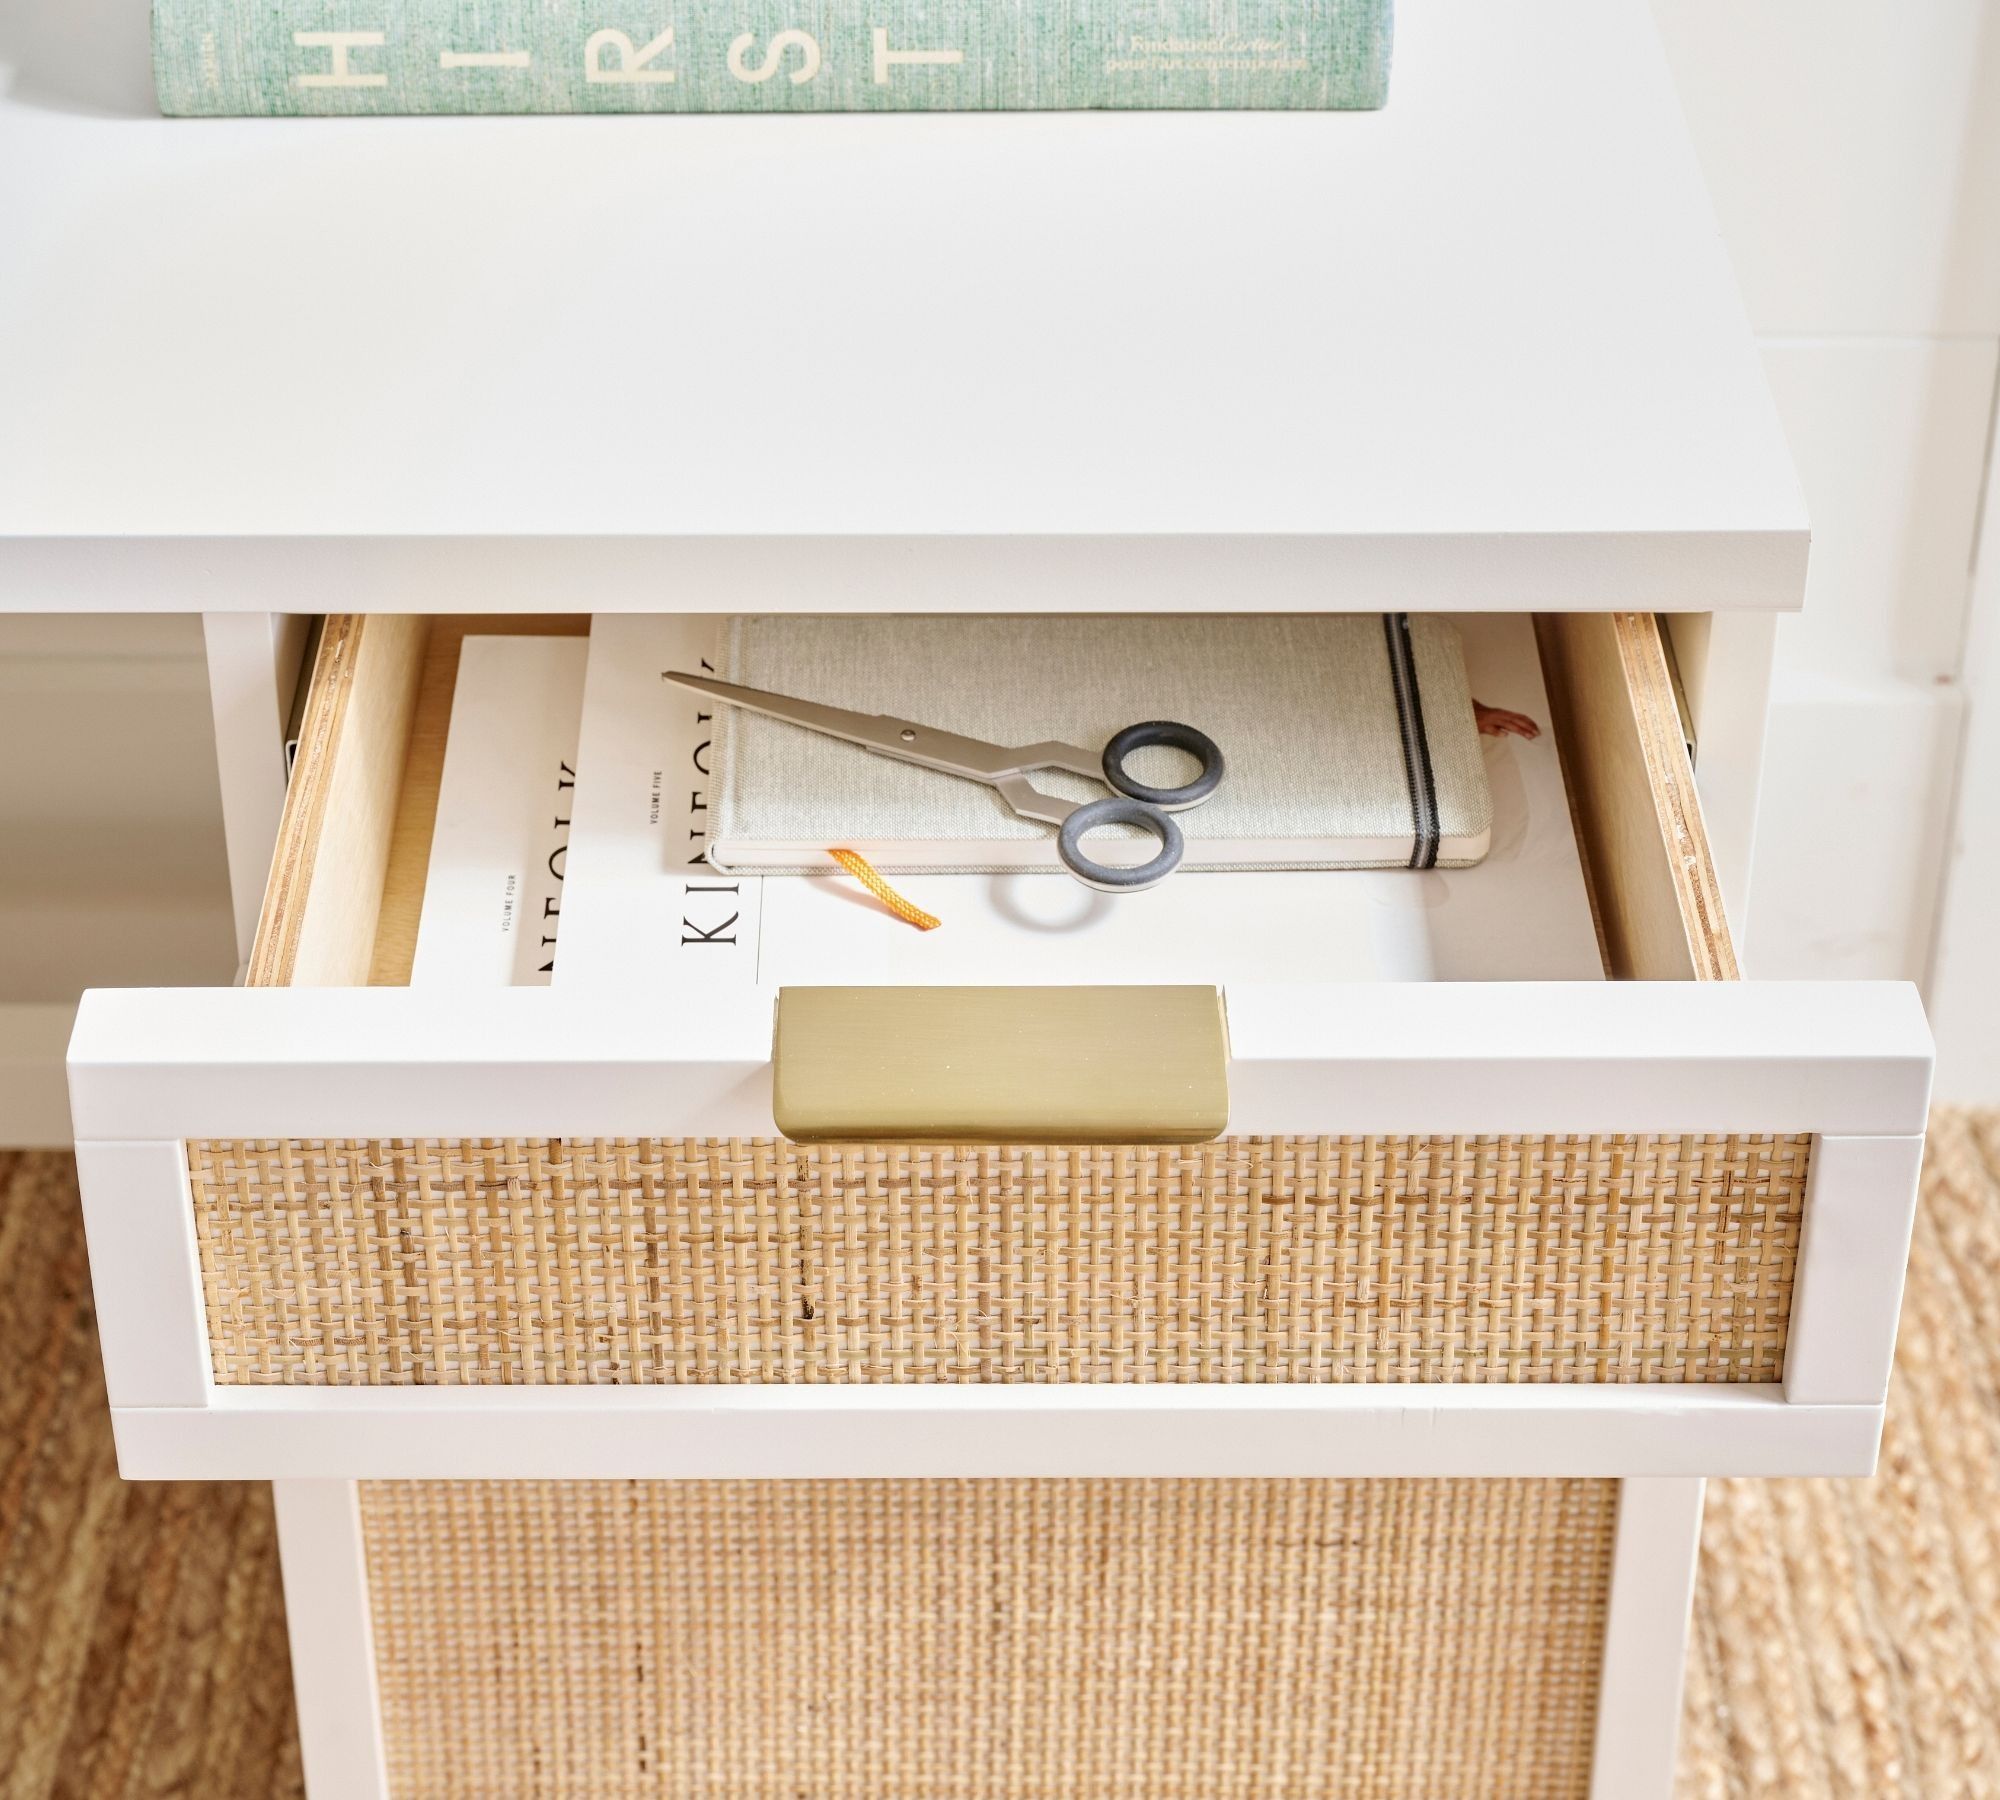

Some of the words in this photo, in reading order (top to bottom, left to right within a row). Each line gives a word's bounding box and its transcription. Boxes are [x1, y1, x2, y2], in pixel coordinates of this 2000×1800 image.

[293, 26, 962, 87] HIRST
[652, 770, 662, 789] FIVE
[650, 792, 660, 825] VOLUME
[505, 874, 516, 896] FOUR
[501, 899, 513, 933] VOLUME
